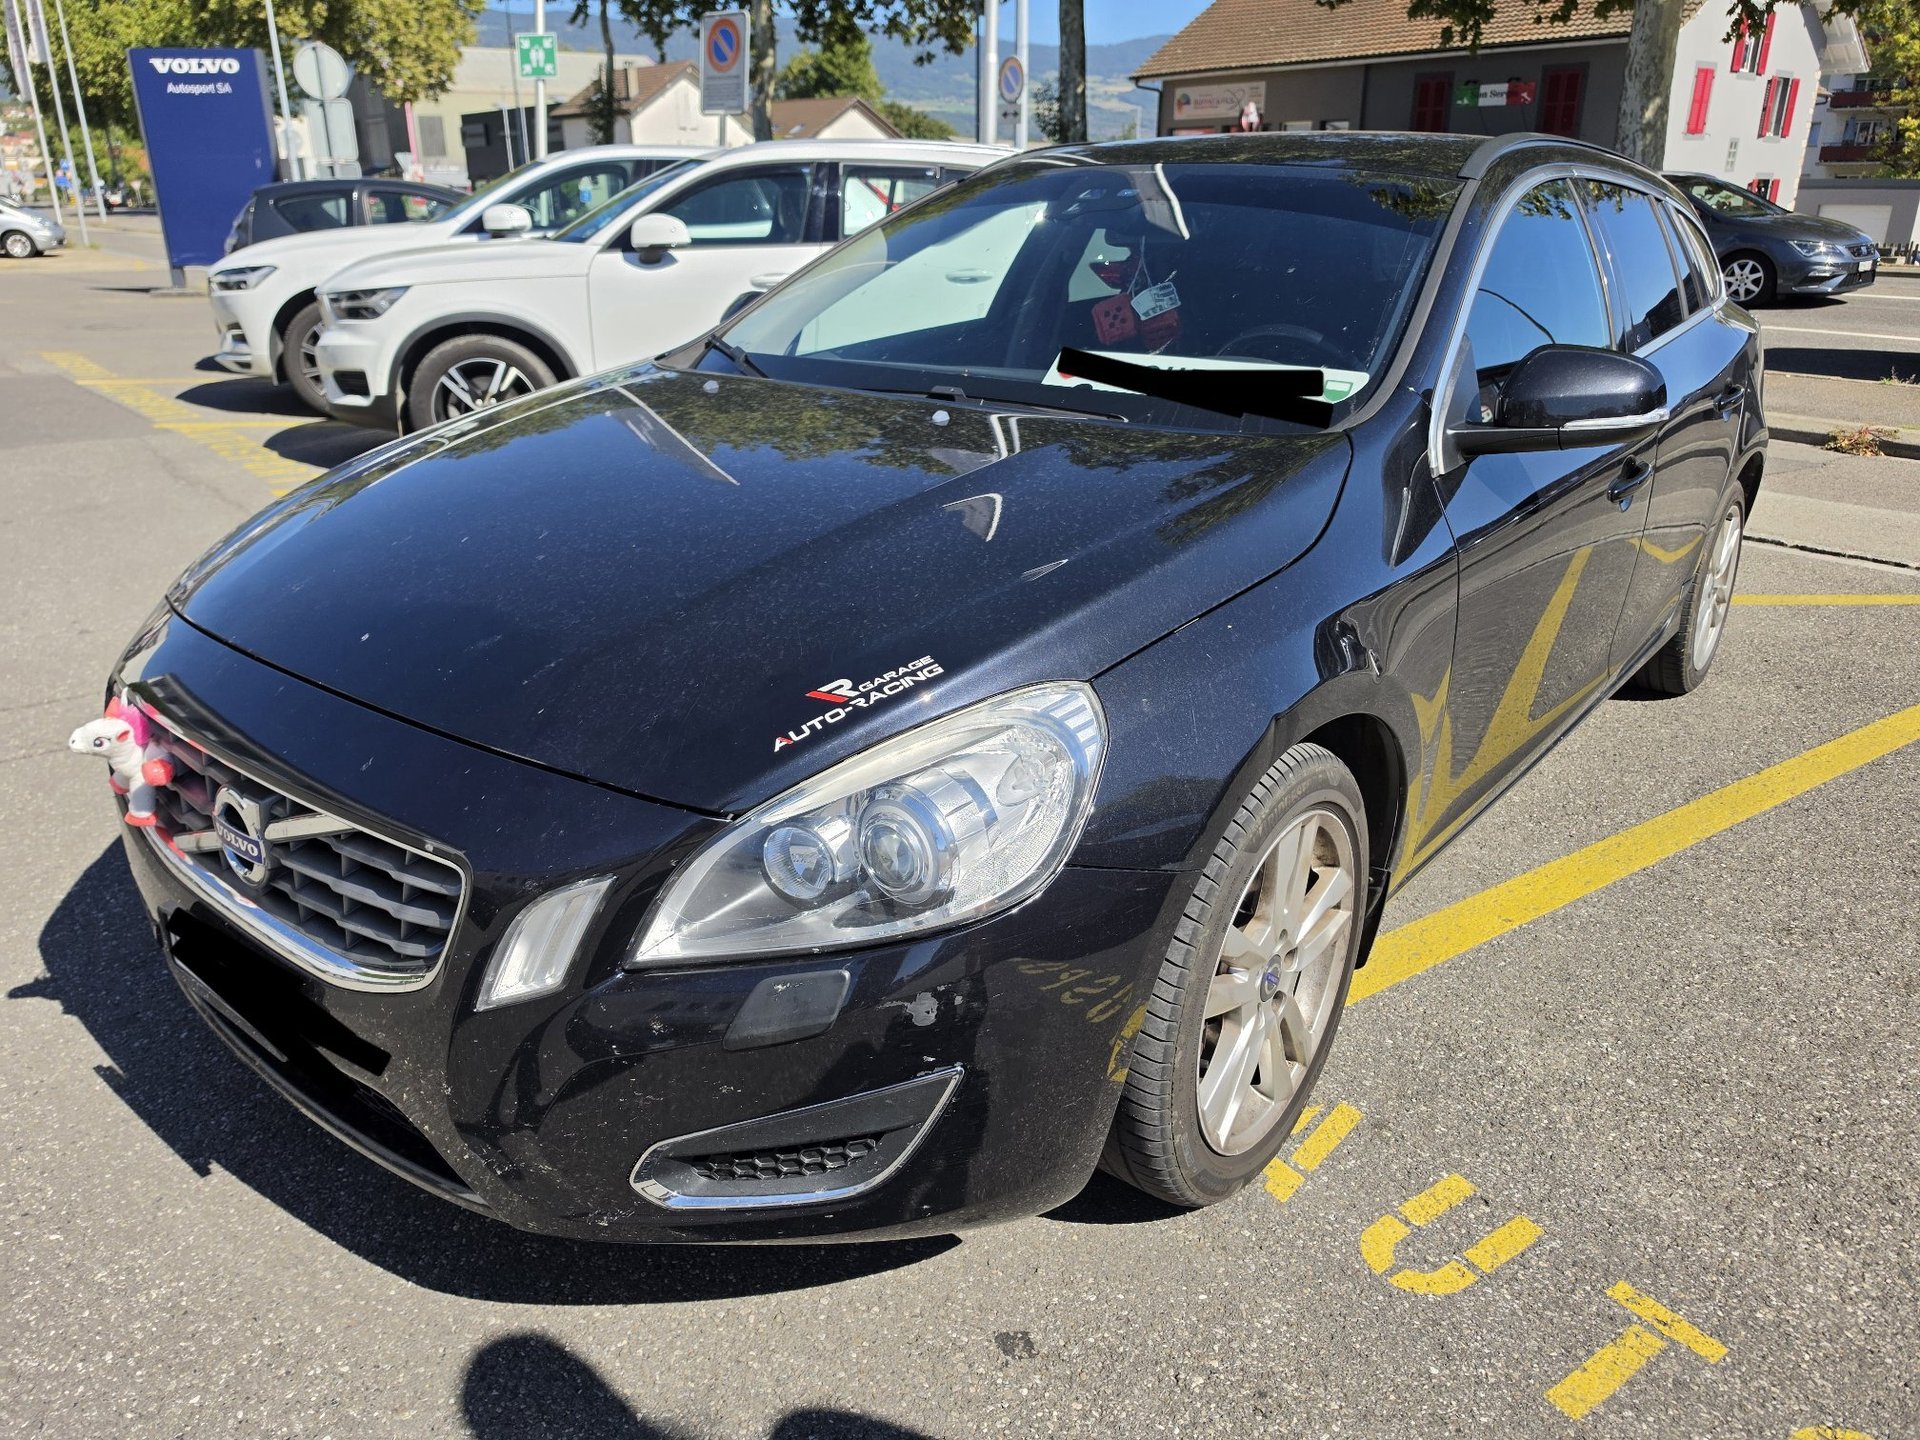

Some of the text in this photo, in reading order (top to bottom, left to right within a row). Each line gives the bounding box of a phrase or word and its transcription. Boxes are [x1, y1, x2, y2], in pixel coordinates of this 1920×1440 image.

[149, 57, 240, 74] VOLVO
[166, 82, 232, 95] Autosport SA
[858, 655, 935, 693] GARAGE
[774, 663, 945, 752] AUTO-RACING
[215, 822, 259, 857] VOLVO
